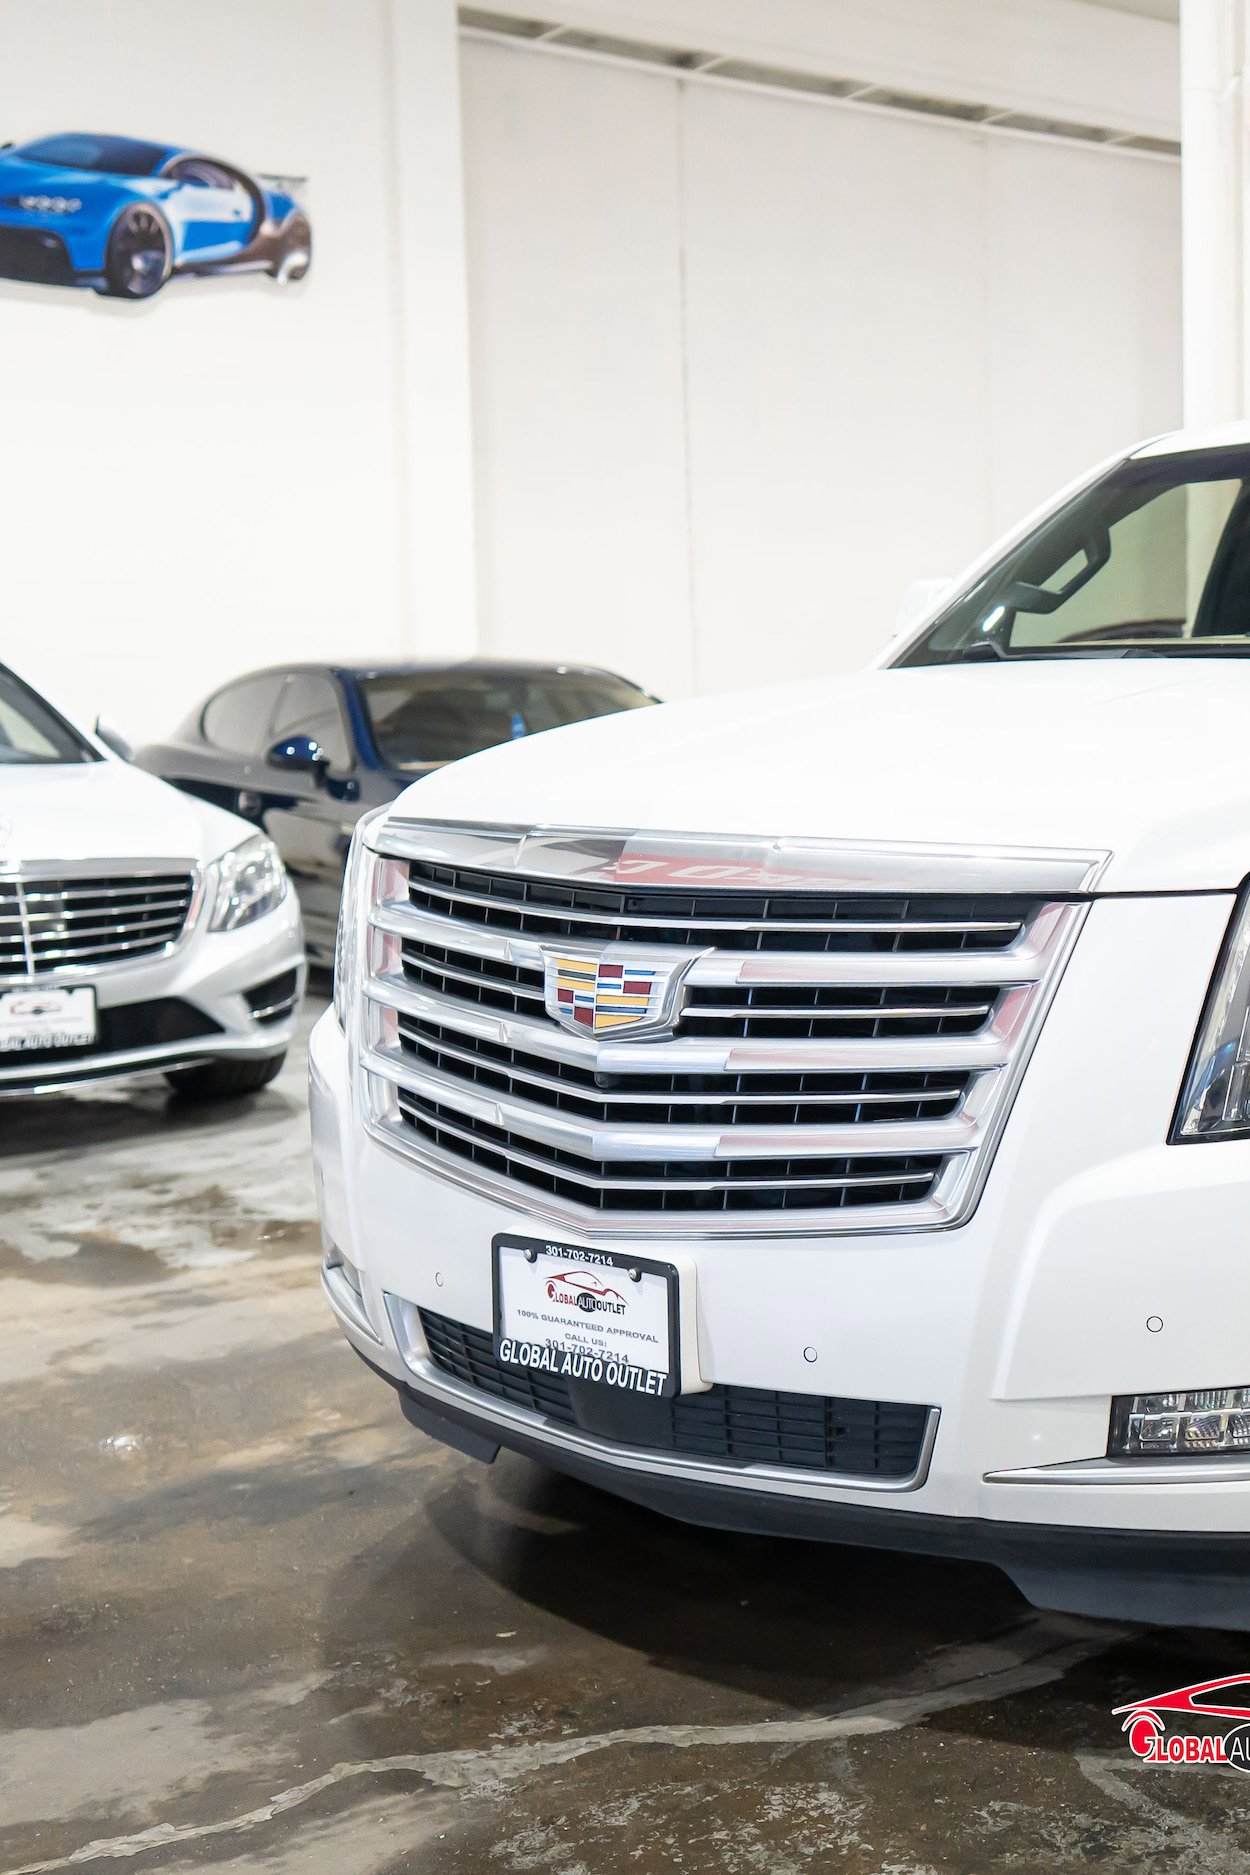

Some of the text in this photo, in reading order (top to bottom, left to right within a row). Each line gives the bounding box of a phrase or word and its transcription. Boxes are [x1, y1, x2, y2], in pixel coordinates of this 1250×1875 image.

[545, 1245, 613, 1267] 301-702-7214
[517, 1309, 659, 1343] 100% GUARANTEED APPROVAL
[564, 1333, 589, 1344] CALL
[545, 1338, 629, 1364] 301-702-7214
[500, 1339, 667, 1396] GLOBAL AUTO OUTLET
